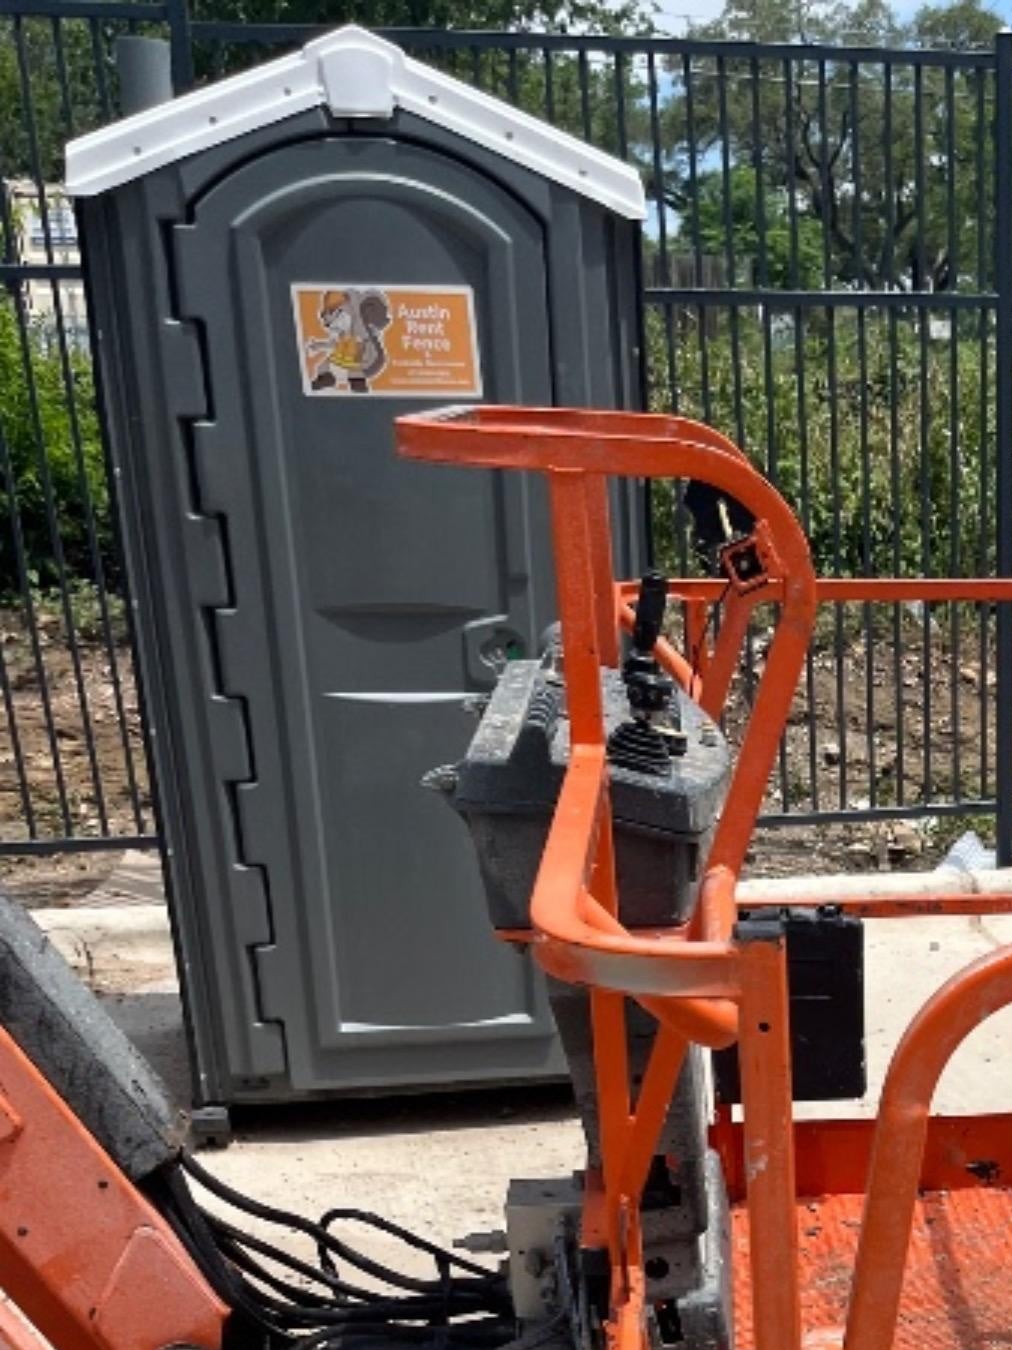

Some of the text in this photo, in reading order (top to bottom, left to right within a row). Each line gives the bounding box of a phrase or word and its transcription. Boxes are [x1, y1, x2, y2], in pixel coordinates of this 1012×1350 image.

[397, 303, 451, 320] Austin
[405, 320, 445, 336] Rent
[400, 335, 451, 352] Fence
